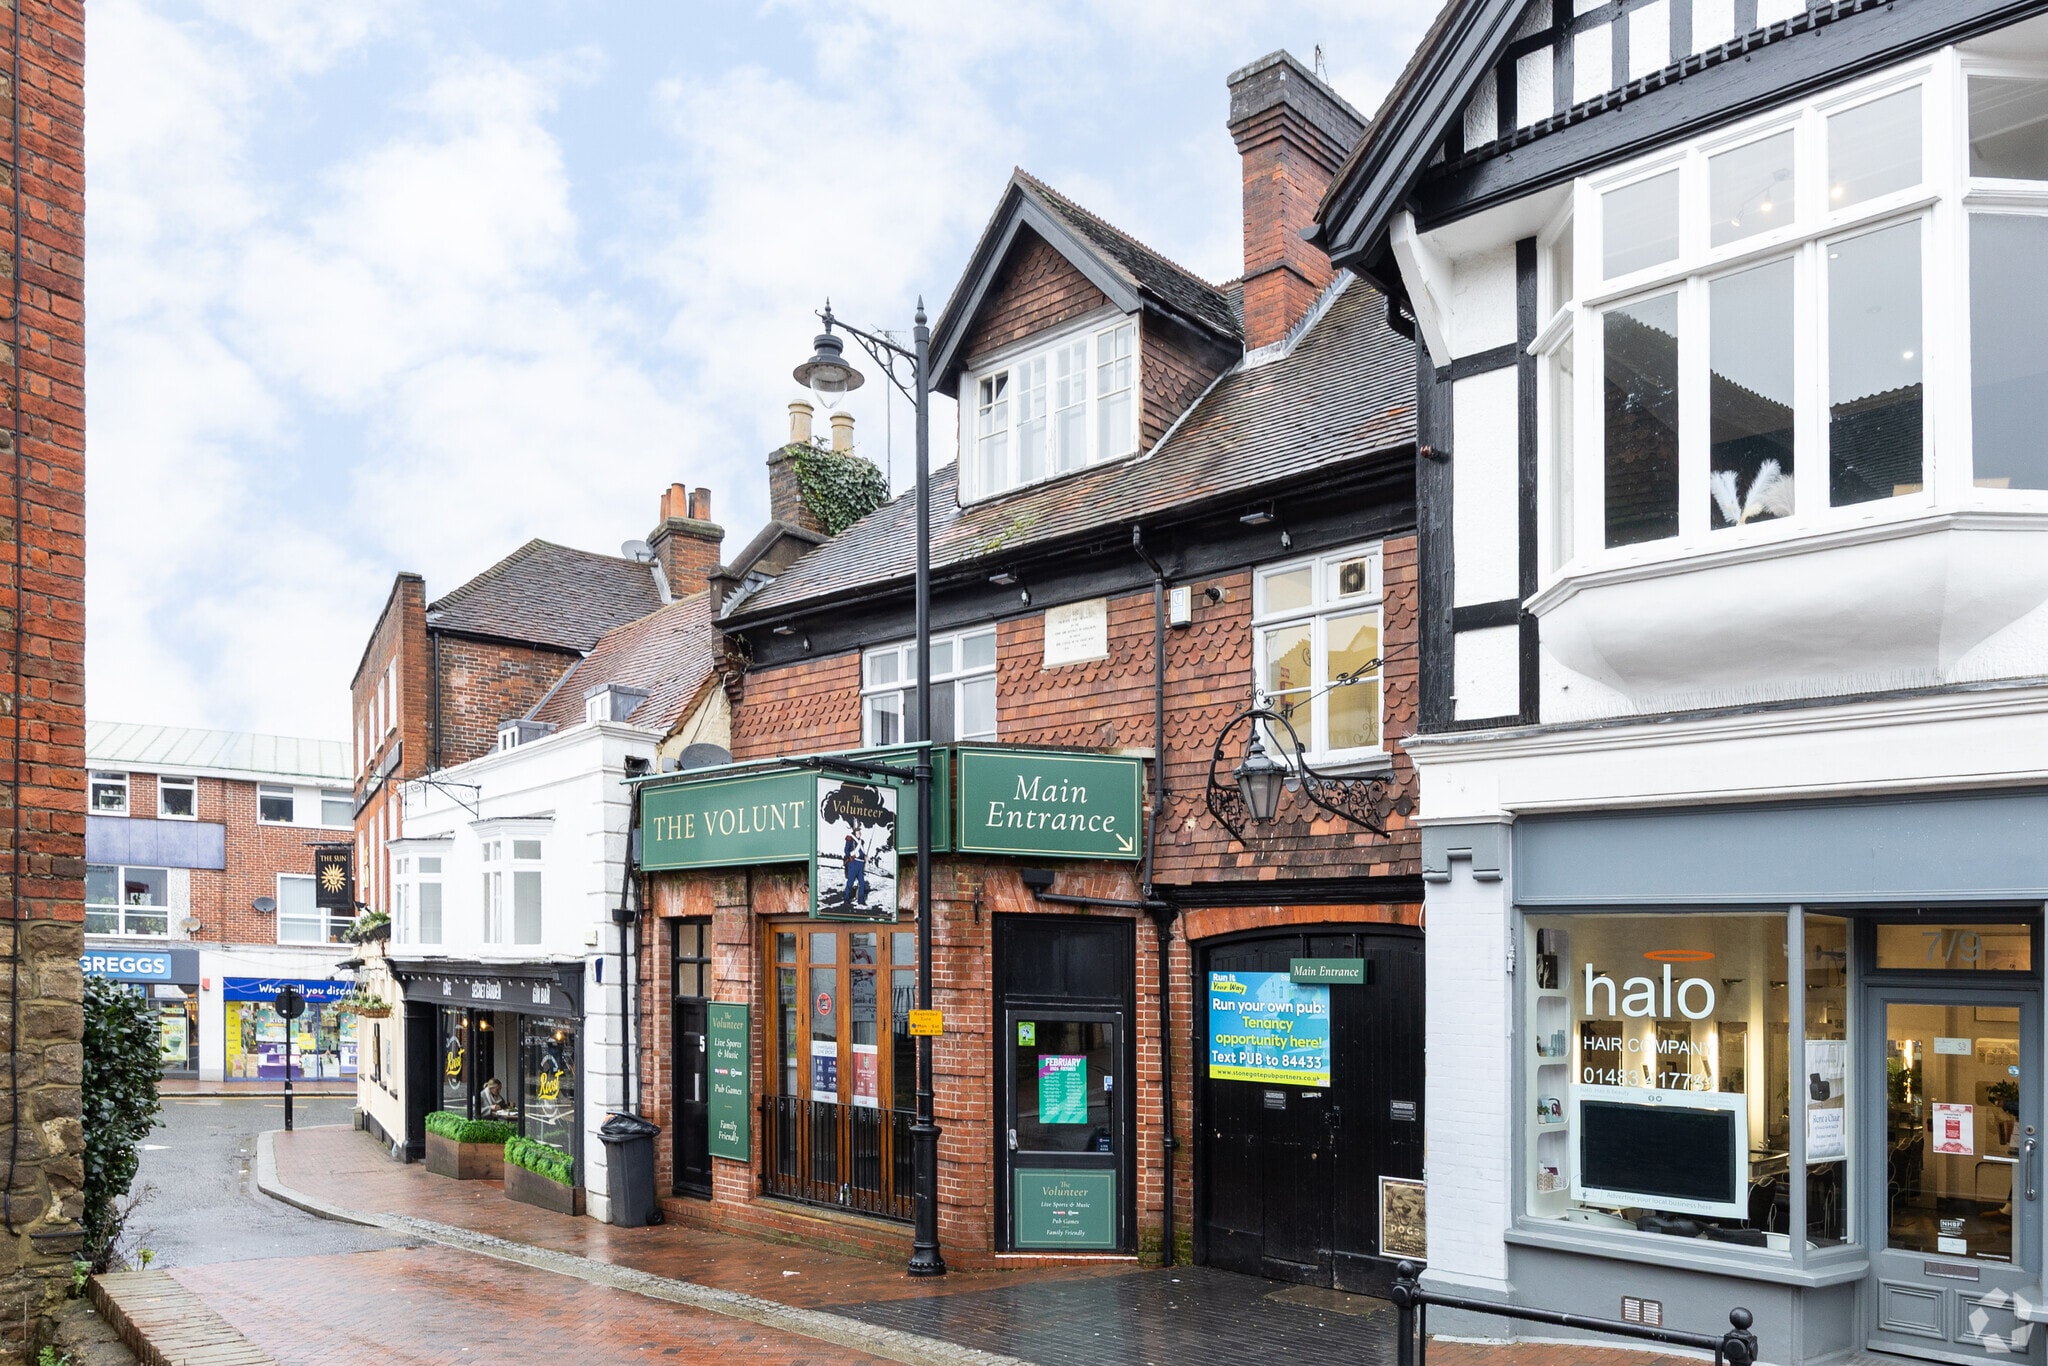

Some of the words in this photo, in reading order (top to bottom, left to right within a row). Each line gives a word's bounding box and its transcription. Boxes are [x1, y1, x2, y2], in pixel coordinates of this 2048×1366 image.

[1013, 775, 1088, 804] Main
[852, 794, 864, 805] The
[833, 799, 885, 819] Volunteer
[653, 813, 696, 842] THE
[703, 800, 811, 837] VOLUNT
[985, 801, 1116, 833] Entrance
[79, 955, 165, 974] GREGGS
[1294, 965, 1316, 976] Main
[1319, 966, 1359, 977] Entrance
[1213, 973, 1228, 981] Run
[306, 986, 325, 998] you
[1229, 984, 1245, 995] Way
[1585, 963, 1716, 1020] halo
[1212, 998, 1236, 1011] Run
[1238, 1001, 1265, 1015] your
[1267, 1002, 1294, 1013] own
[1296, 1001, 1326, 1016] pub:
[713, 1017, 744, 1030] Volunteer
[1242, 1016, 1294, 1033] Tenancy
[699, 1035, 706, 1052] 5
[714, 1037, 726, 1047] Live
[726, 1038, 742, 1050] Sports
[1215, 1034, 1288, 1050] opportunity
[1289, 1035, 1323, 1049] here!
[1583, 1036, 1623, 1051] HAIR
[1627, 1037, 1716, 1056] COMPANY
[717, 1049, 723, 1058] &
[724, 1049, 739, 1060] Music
[1211, 1050, 1237, 1064] Text
[1239, 1051, 1263, 1065] PUB
[1265, 1056, 1279, 1066] to
[1281, 1054, 1322, 1069] 84433
[1045, 1058, 1081, 1067] FEBRUARY
[1217, 1069, 1321, 1082] www.stonegatepubpartners.co.uk
[1583, 1067, 1640, 1087] 01483
[714, 1083, 725, 1093] Pub
[726, 1085, 742, 1096] Games
[720, 1119, 737, 1132] Family
[718, 1130, 740, 1145] Friendly
[1042, 1186, 1089, 1197] Volunteer
[1046, 1229, 1063, 1237] Family
[1064, 1229, 1086, 1238] Friendly
